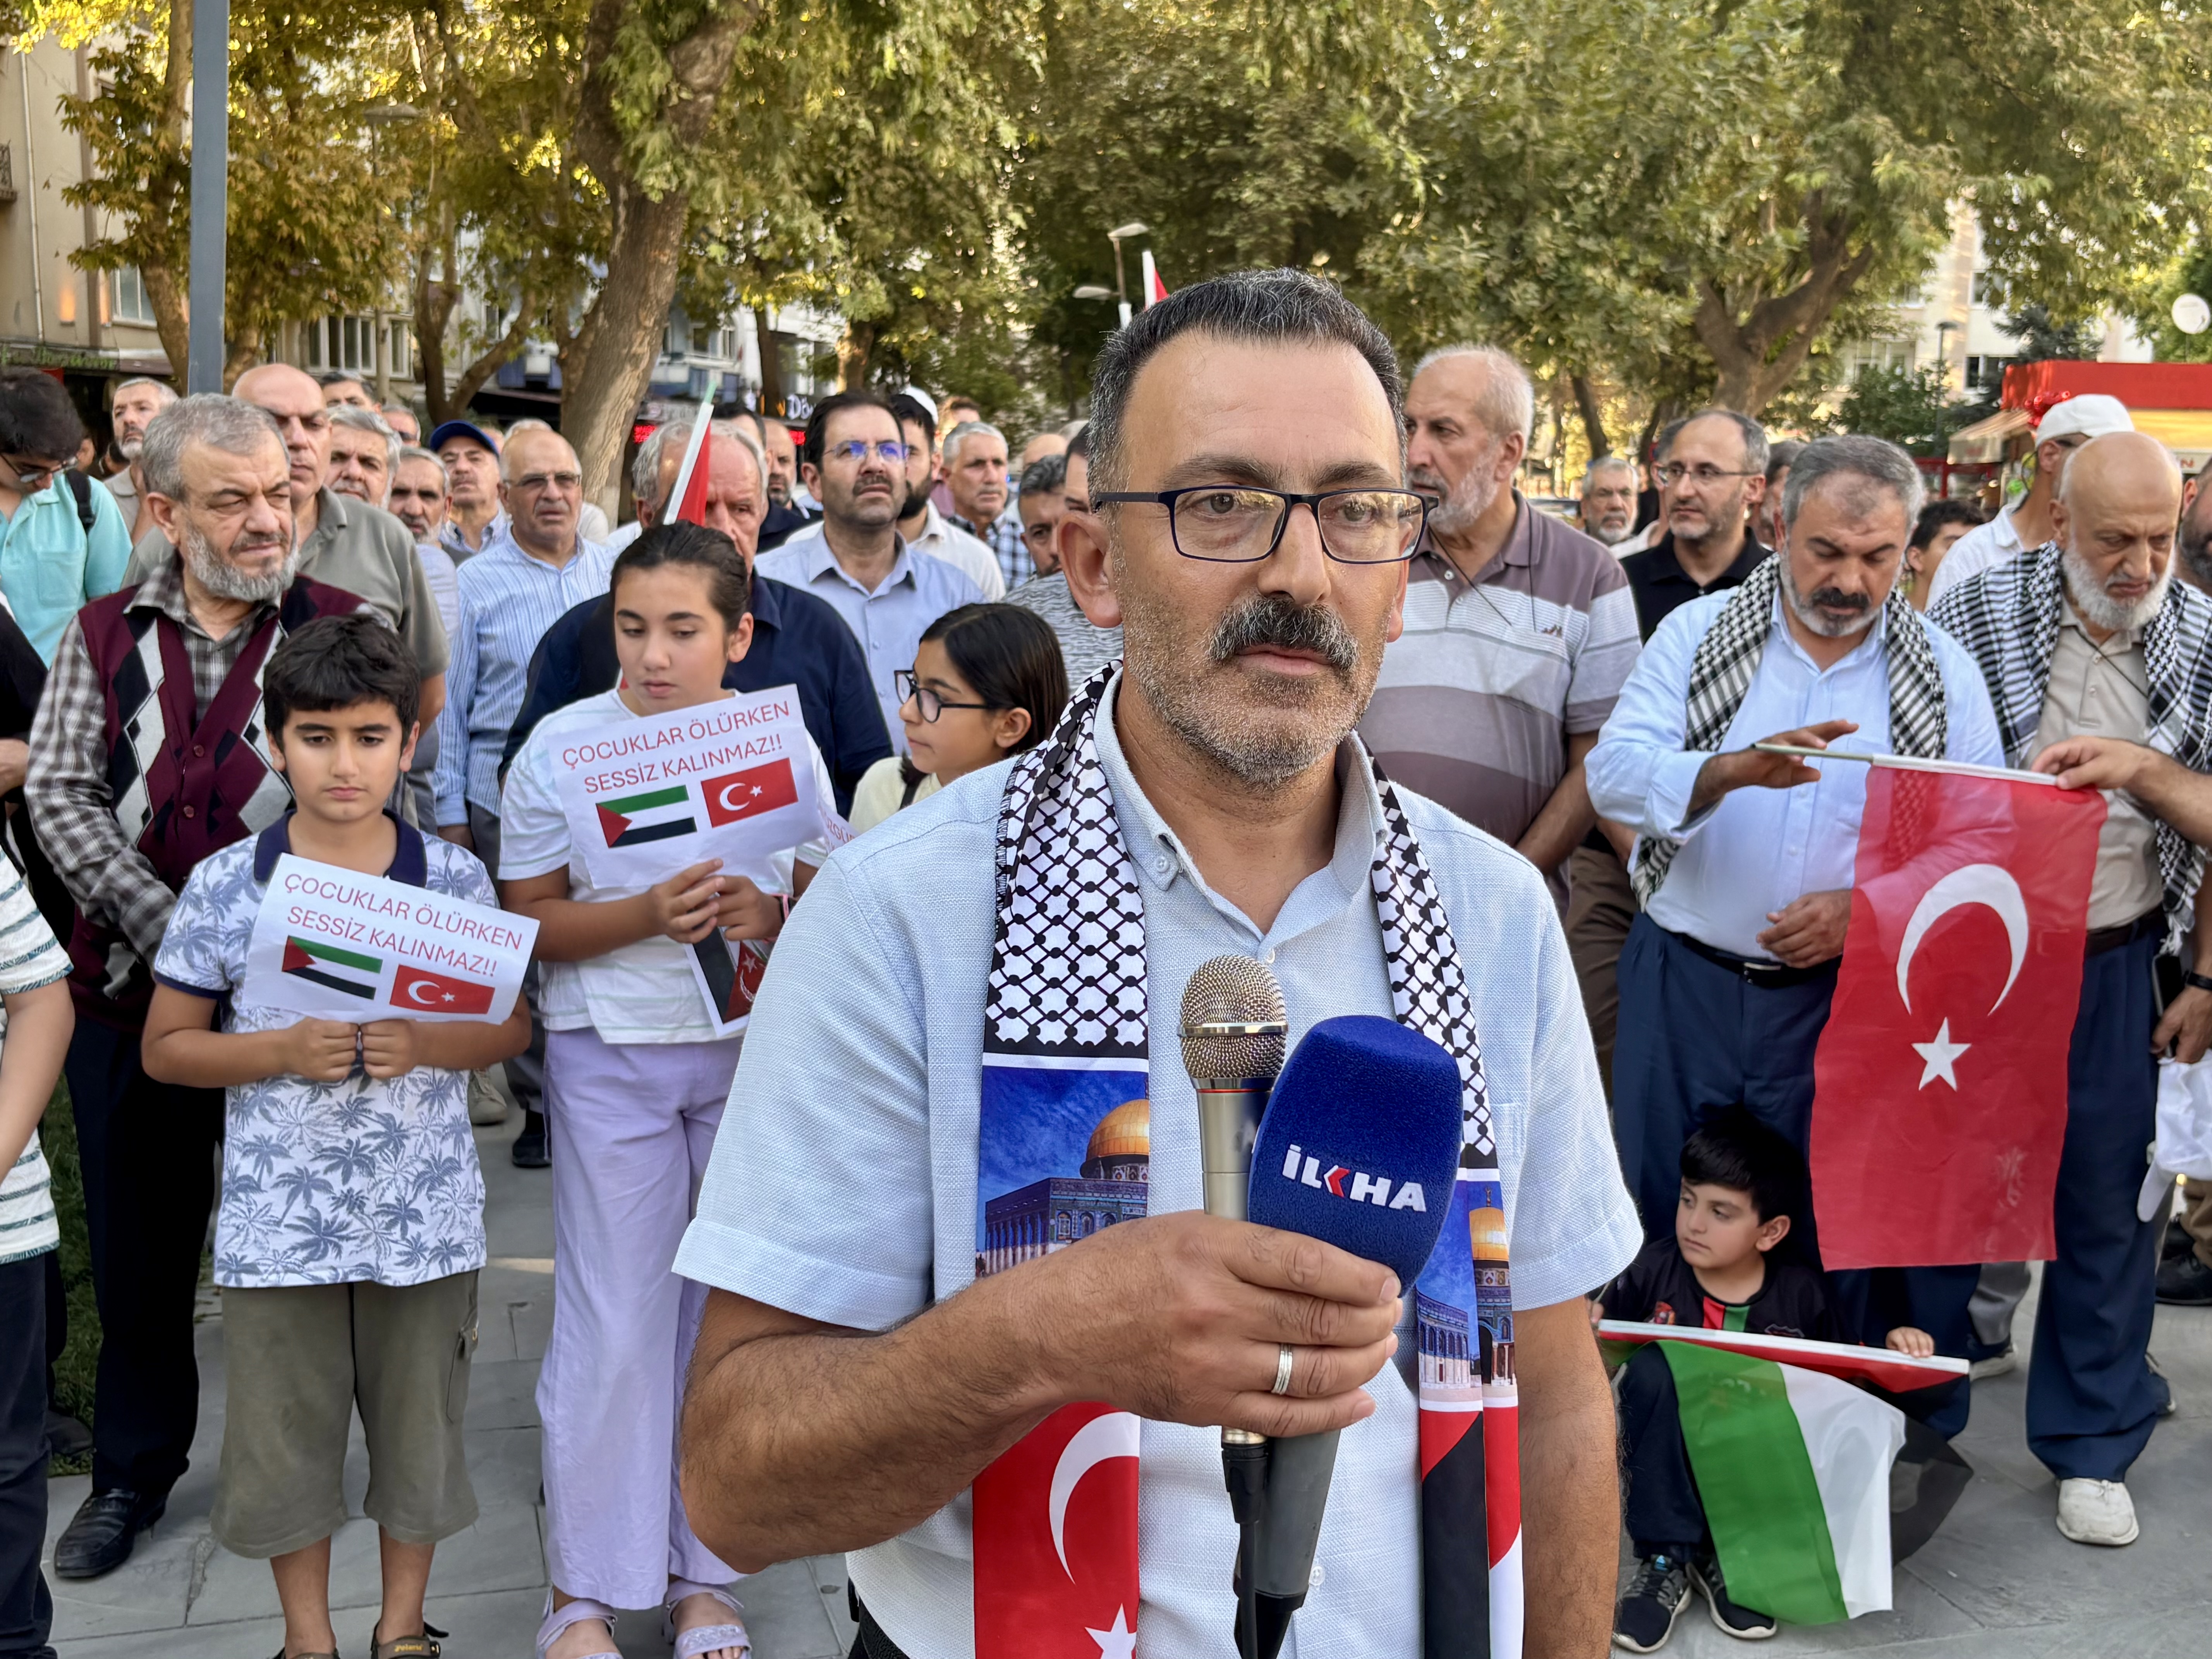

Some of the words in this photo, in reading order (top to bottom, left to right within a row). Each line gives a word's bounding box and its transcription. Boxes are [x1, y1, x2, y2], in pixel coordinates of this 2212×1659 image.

[563, 727, 684, 770] ÇOCUKLAR
[689, 701, 790, 740] ÖLÜRKEN
[584, 763, 659, 793] SESSİZ
[662, 734, 783, 778] KALINMAZ!!
[285, 874, 410, 920] ÇOCUKLAR
[416, 903, 522, 950] ÖLÜRKEN
[287, 906, 366, 942] SESSİZ
[369, 928, 497, 977] KALINMAZ!!
[1282, 1144, 1426, 1212] İLKHA
